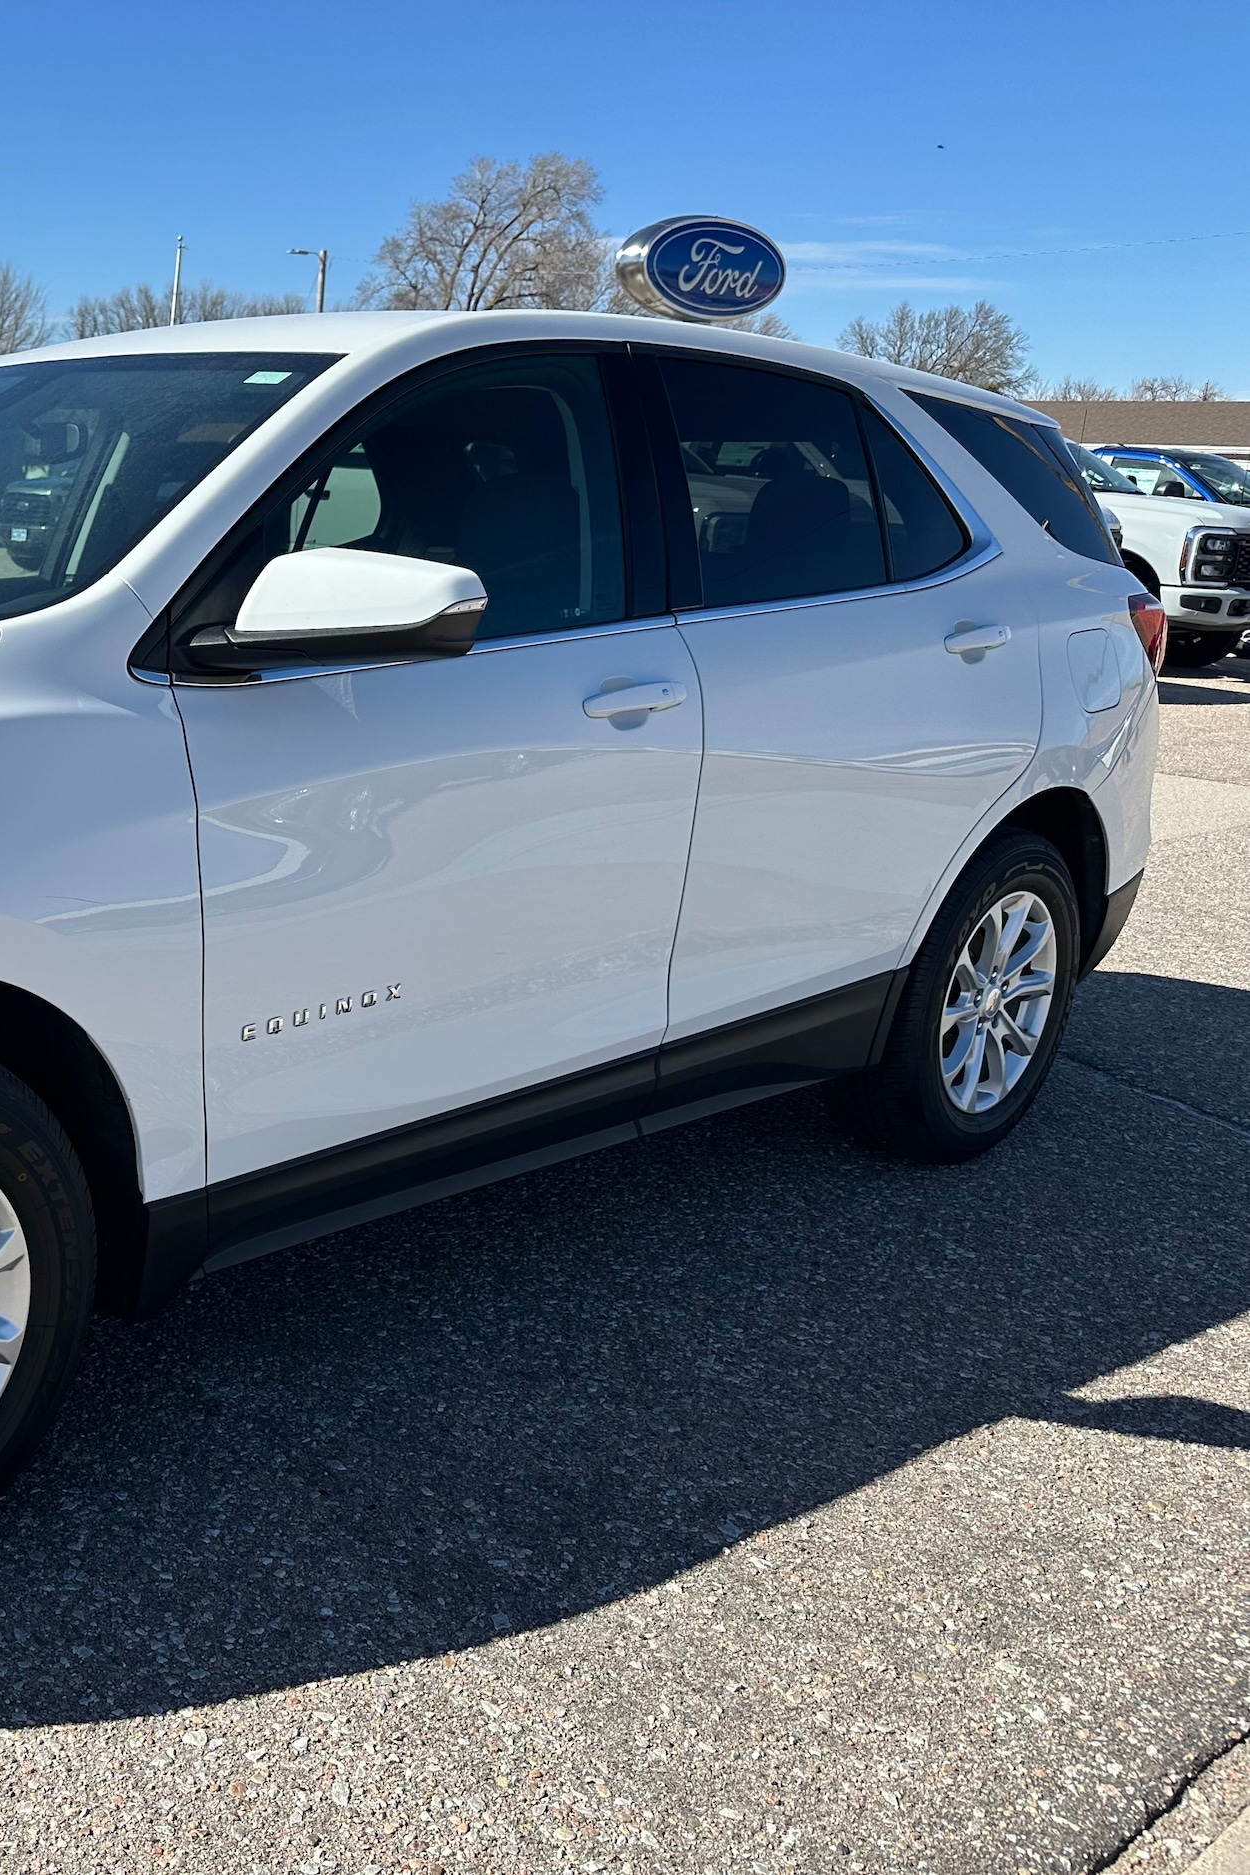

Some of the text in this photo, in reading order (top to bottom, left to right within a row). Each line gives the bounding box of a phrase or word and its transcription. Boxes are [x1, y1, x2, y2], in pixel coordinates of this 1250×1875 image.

[677, 238, 763, 298] Ford
[947, 881, 996, 968] TOYO
[241, 983, 402, 1041] EQUINOX
[16, 1139, 81, 1322] EXTENSA
